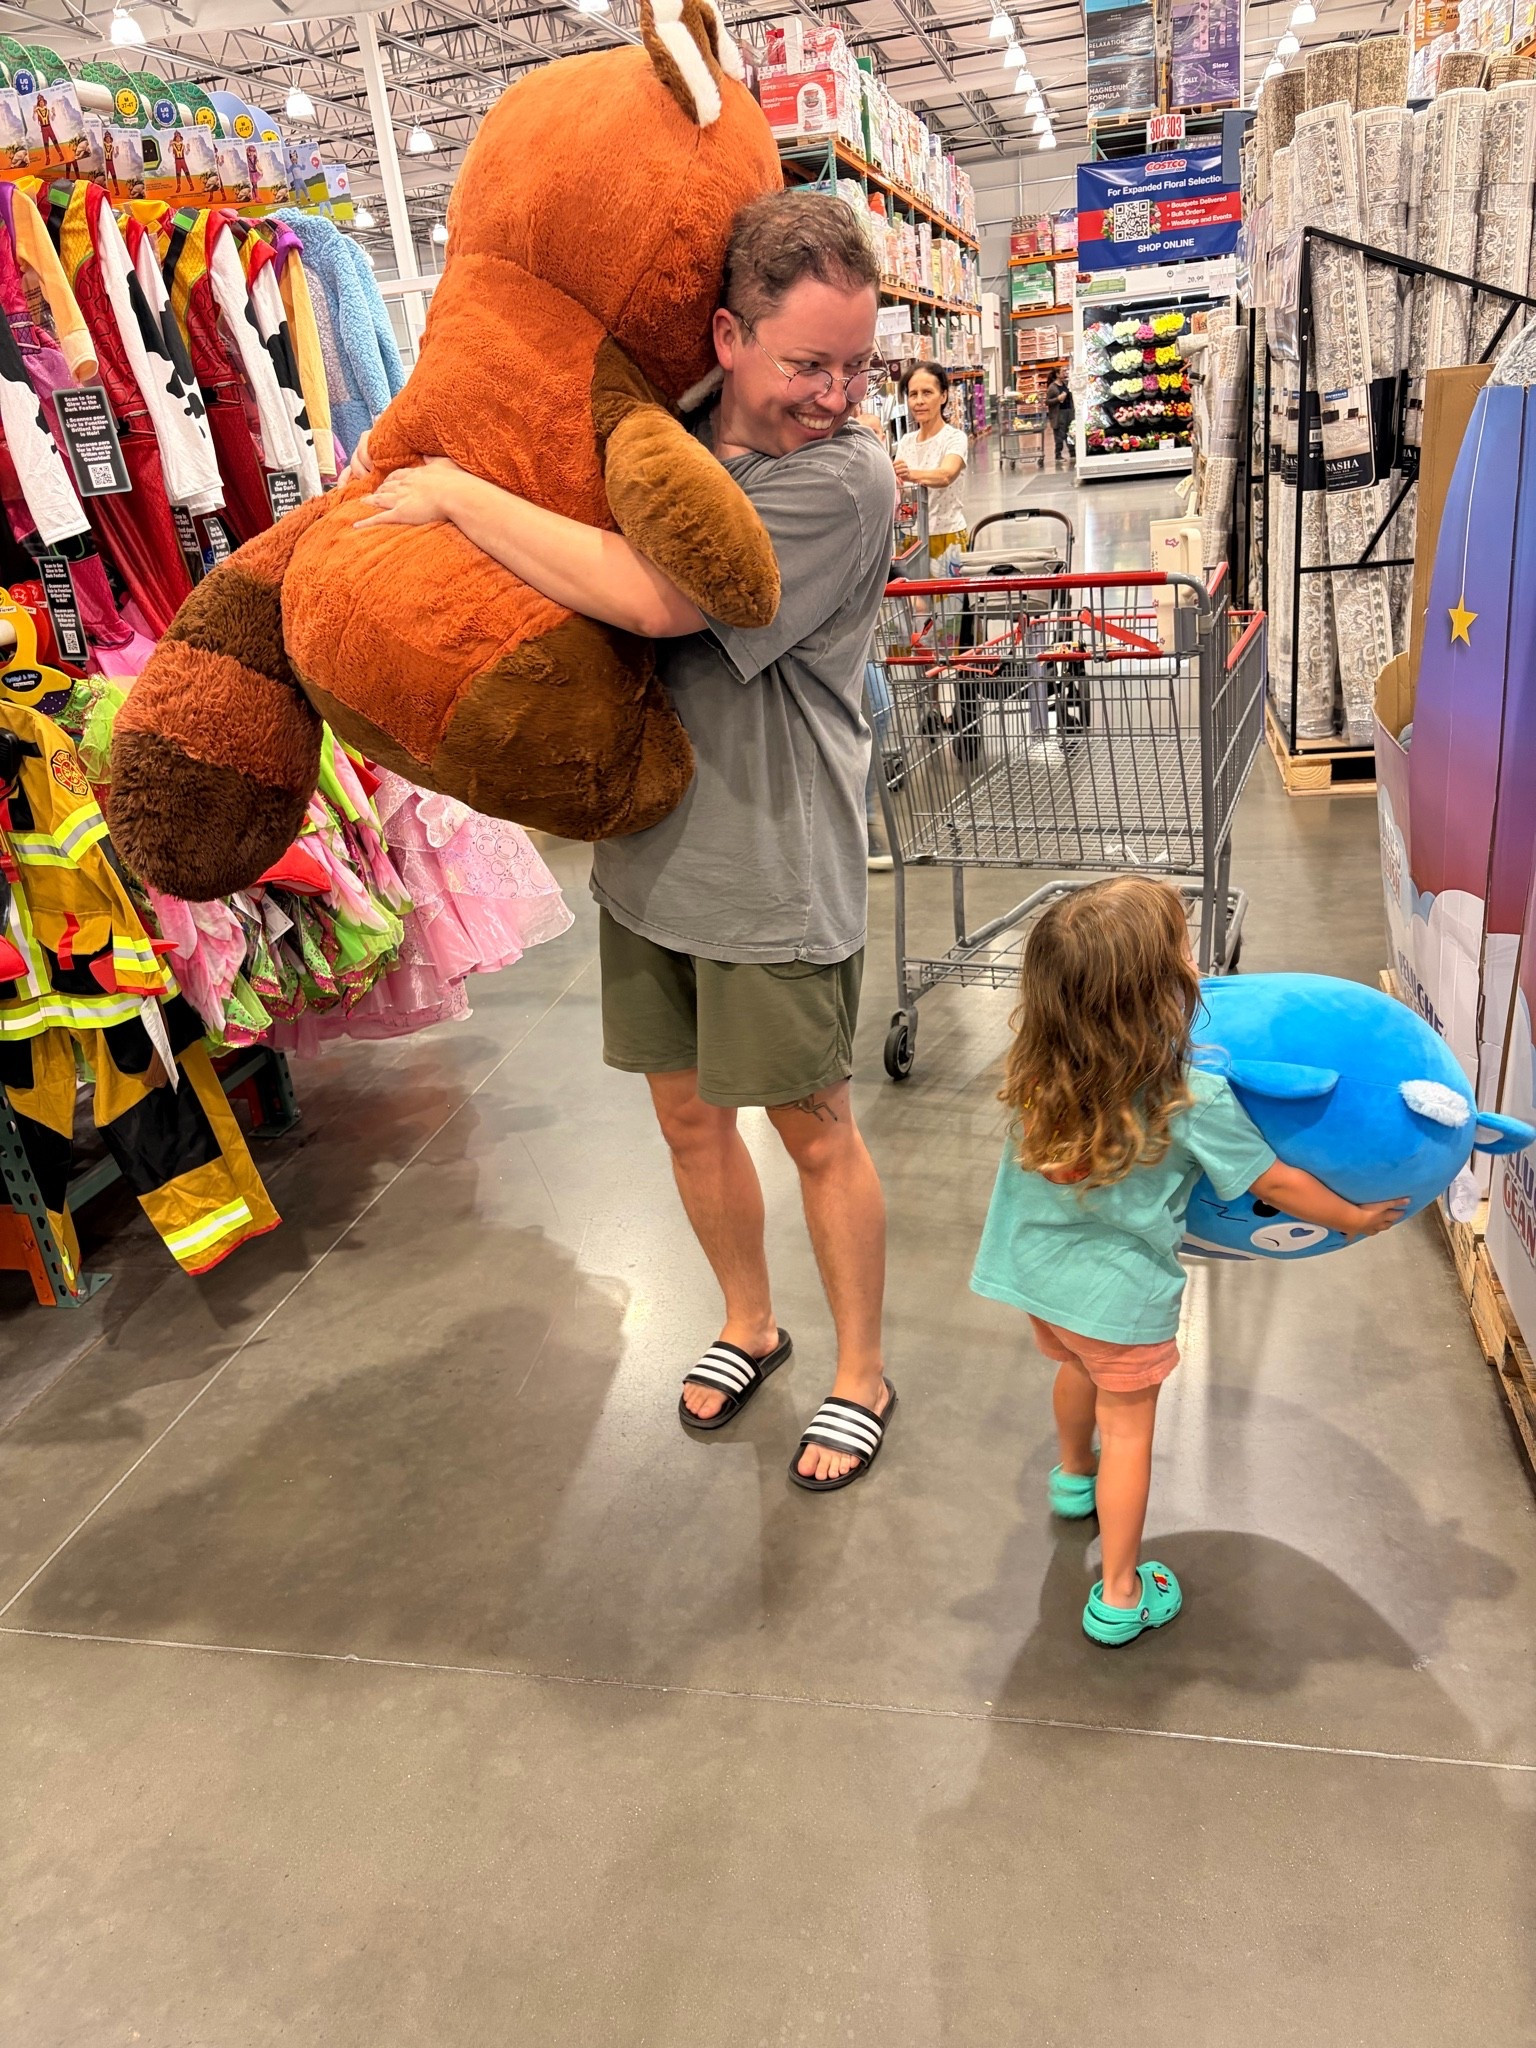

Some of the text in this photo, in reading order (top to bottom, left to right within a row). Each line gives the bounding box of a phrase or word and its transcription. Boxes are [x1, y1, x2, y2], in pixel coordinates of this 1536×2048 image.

[1088, 38, 1125, 49] RELAXATION
[1089, 84, 1128, 94] MAGNESIUM
[1090, 92, 1120, 101] FORMULA
[1150, 116, 1165, 142] 302
[1166, 116, 1182, 138] 303
[1146, 160, 1186, 172] COSTCO
[1108, 175, 1222, 196] For Expanded Floral Selectio
[1171, 196, 1227, 210] Bouquets Delivered
[1185, 208, 1206, 216] Orders
[1171, 218, 1199, 227] Weddings
[1212, 213, 1232, 222] Events
[1138, 238, 1194, 253] SHOP ONLINE
[1286, 456, 1298, 466] SAS
[1326, 458, 1360, 472] SASHA
[1503, 1172, 1536, 1260] GÉAN
